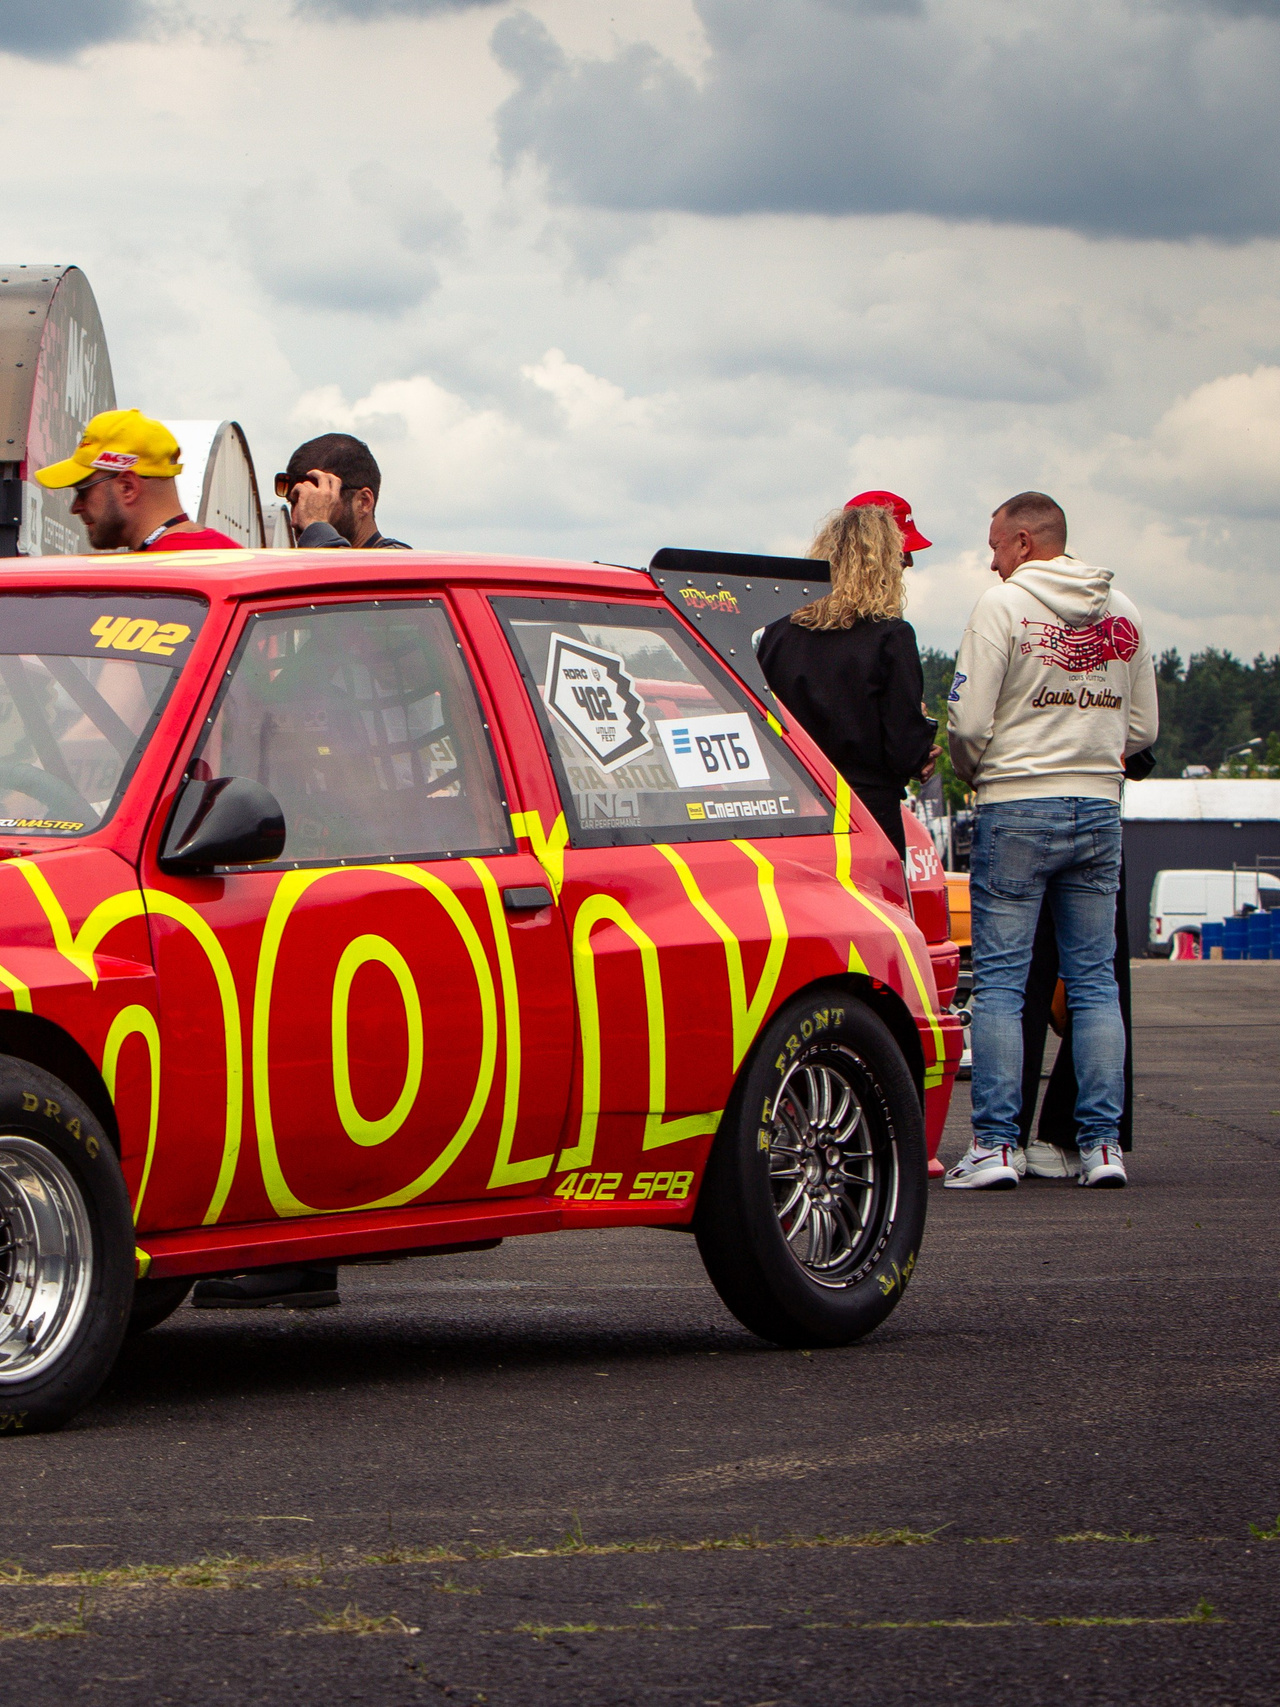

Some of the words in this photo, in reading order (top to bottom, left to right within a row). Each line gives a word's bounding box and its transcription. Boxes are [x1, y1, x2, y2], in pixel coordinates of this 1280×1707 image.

[89, 614, 192, 656] 402
[562, 667, 589, 681] RDRC
[570, 686, 618, 722] 402
[1032, 685, 1076, 709] Louis
[601, 734, 616, 743] FEST
[694, 732, 750, 773] ВТБ
[580, 820, 595, 830] CAR
[595, 817, 641, 830] PERFORMANCE
[704, 801, 778, 819] Степанов
[774, 1008, 846, 1077] FRONT
[22, 1090, 101, 1160] DRAG
[554, 1172, 624, 1200] 402
[628, 1171, 695, 1200] SPB
